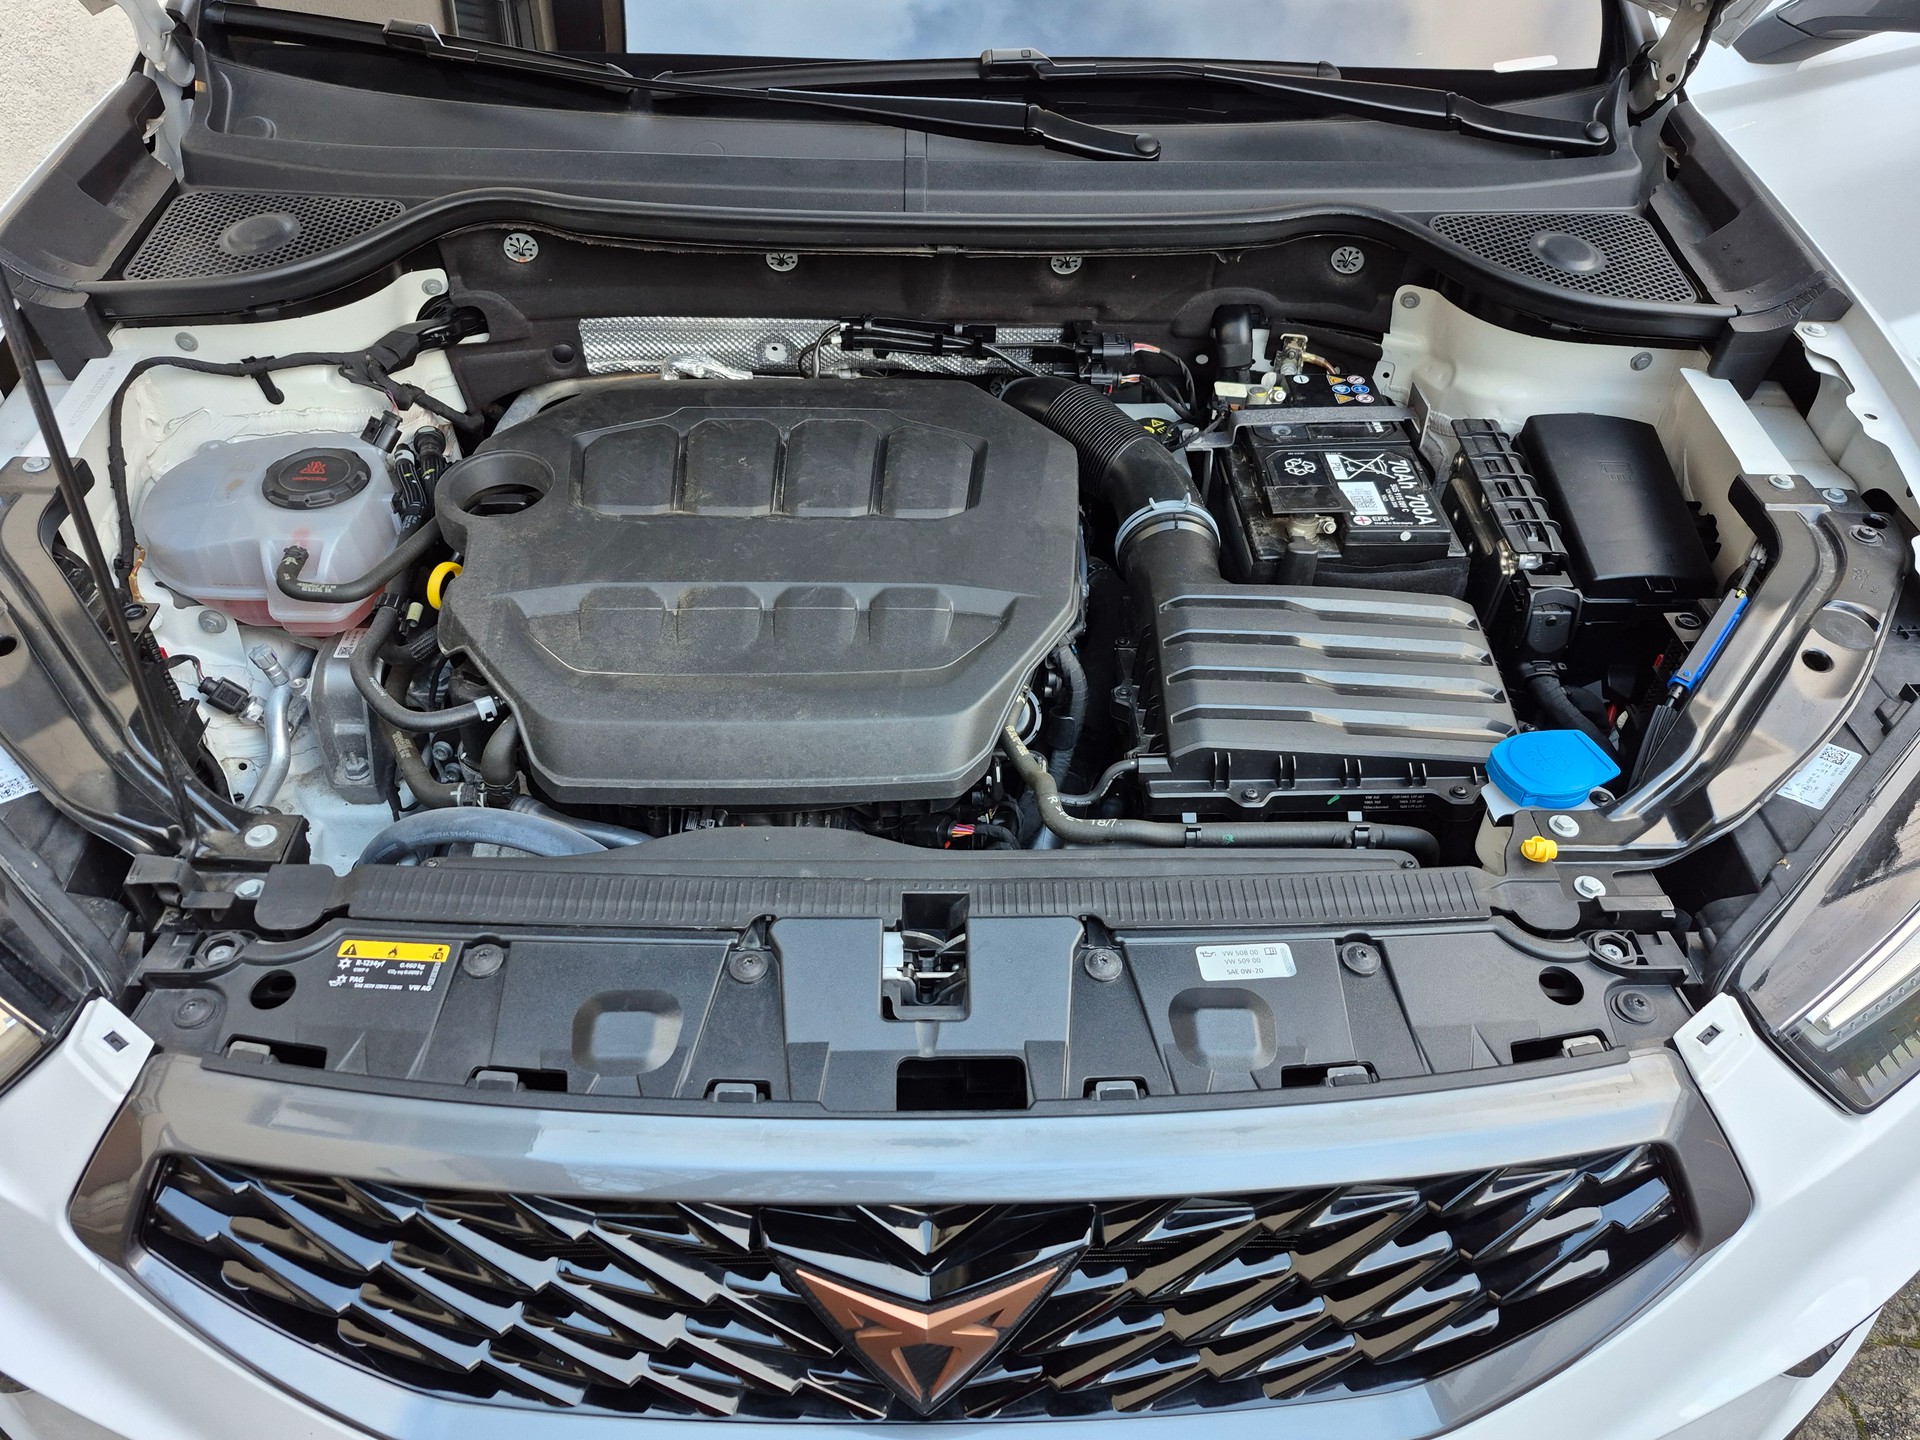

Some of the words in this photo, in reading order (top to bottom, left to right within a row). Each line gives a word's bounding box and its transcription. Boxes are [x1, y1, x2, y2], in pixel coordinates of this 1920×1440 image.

[1332, 462, 1341, 472] Pb
[1388, 460, 1418, 489] 70Ah
[1404, 494, 1437, 525] 700A
[355, 959, 386, 969] R-1234yf
[348, 976, 365, 984] PAG
[408, 984, 421, 992] VW
